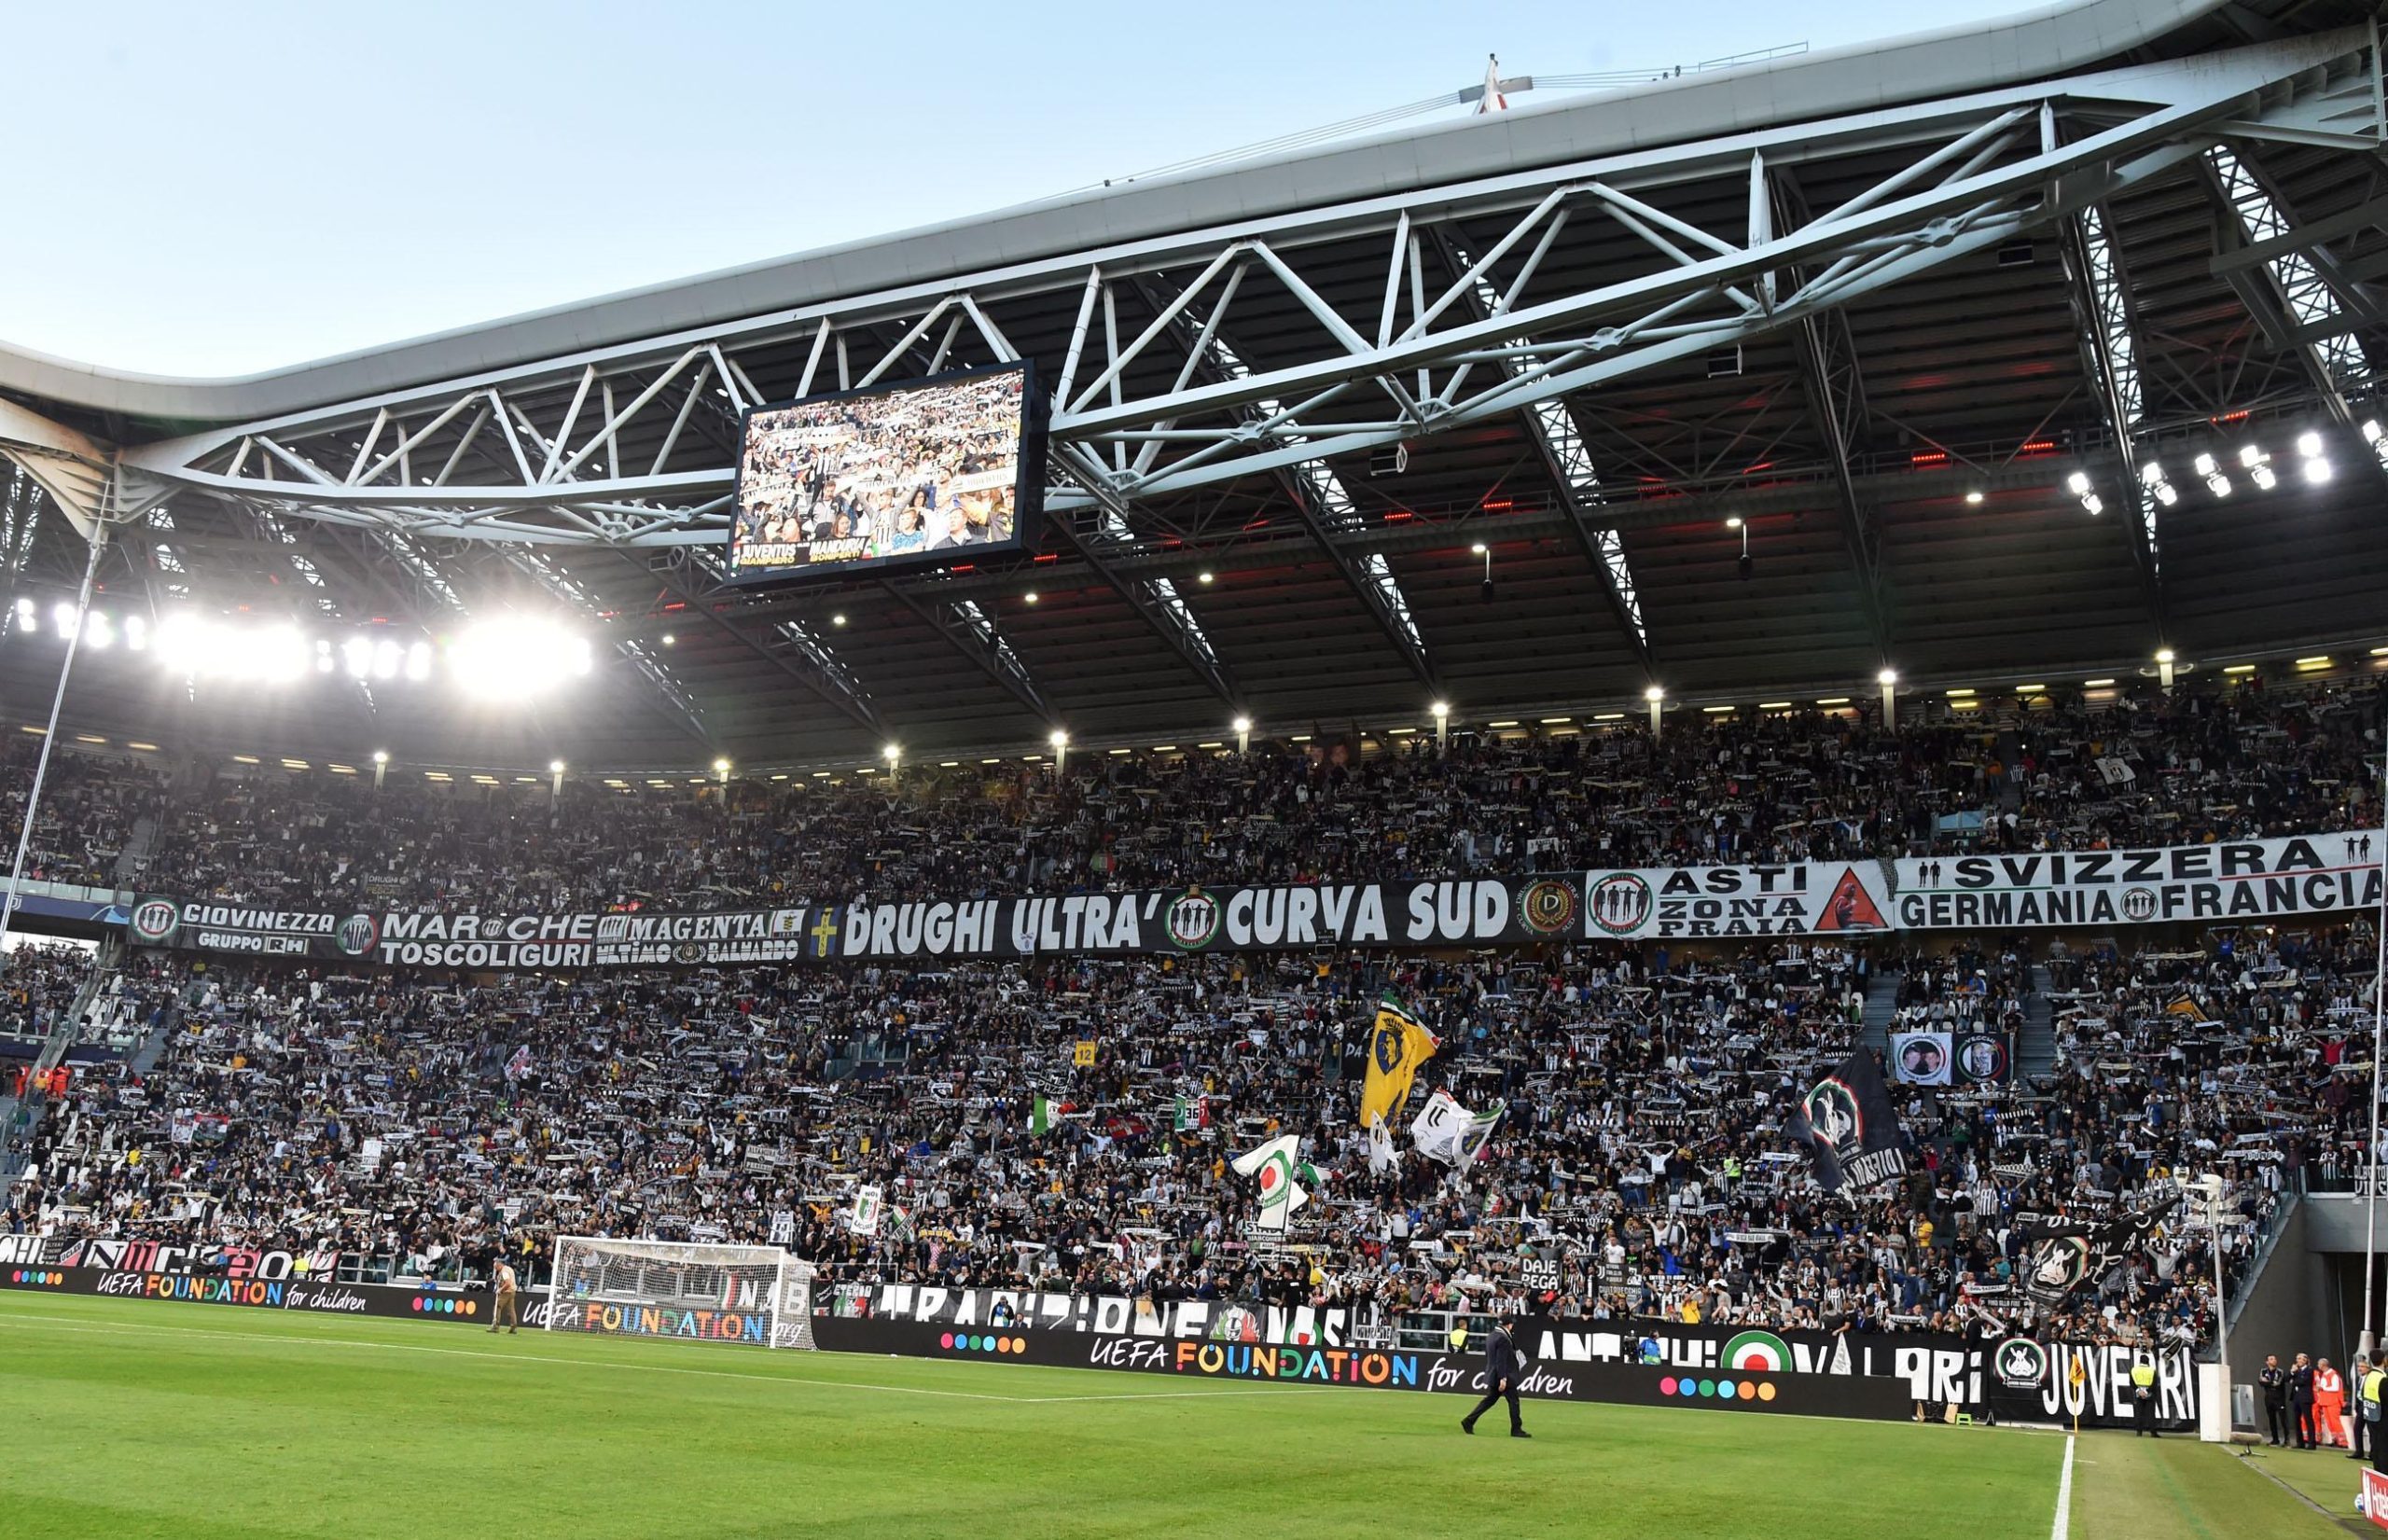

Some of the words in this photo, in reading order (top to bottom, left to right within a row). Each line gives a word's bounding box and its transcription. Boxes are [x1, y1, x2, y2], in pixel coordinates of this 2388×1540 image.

[742, 543, 796, 559] JUVENTUS
[1955, 838, 2325, 888] SVIZZERA
[1660, 866, 1807, 895] ASTI
[1659, 896, 1808, 921] ZONA
[1900, 889, 2117, 927] GERMANIA
[2161, 867, 2383, 919] FRANCIA
[184, 903, 336, 933] GIOVINEZZA
[628, 913, 767, 941] MAGENTA
[843, 900, 998, 956] DRUGHI
[1012, 893, 1161, 950] ULTRA'
[1227, 884, 1389, 946] CURVA
[1408, 881, 1509, 939] SUD
[1562, 918, 1576, 933] SUD
[1659, 918, 1808, 936] PRAIA
[199, 932, 262, 950] GRUPPO
[380, 941, 593, 967] TOSCOLIGURI
[706, 939, 799, 964] BALUARDO
[1079, 1048, 1091, 1061] 12
[1186, 1107, 1199, 1119] 36
[1523, 1258, 1557, 1274] DAJE
[97, 1271, 143, 1295] UEFA
[285, 1285, 309, 1310] for
[310, 1286, 367, 1311] children
[523, 1300, 581, 1327] UEFA
[1090, 1337, 1169, 1368] UEFA
[1427, 1356, 1465, 1392] for
[1472, 1365, 1573, 1394] cdren
[2042, 1344, 2134, 1419] JUVE
